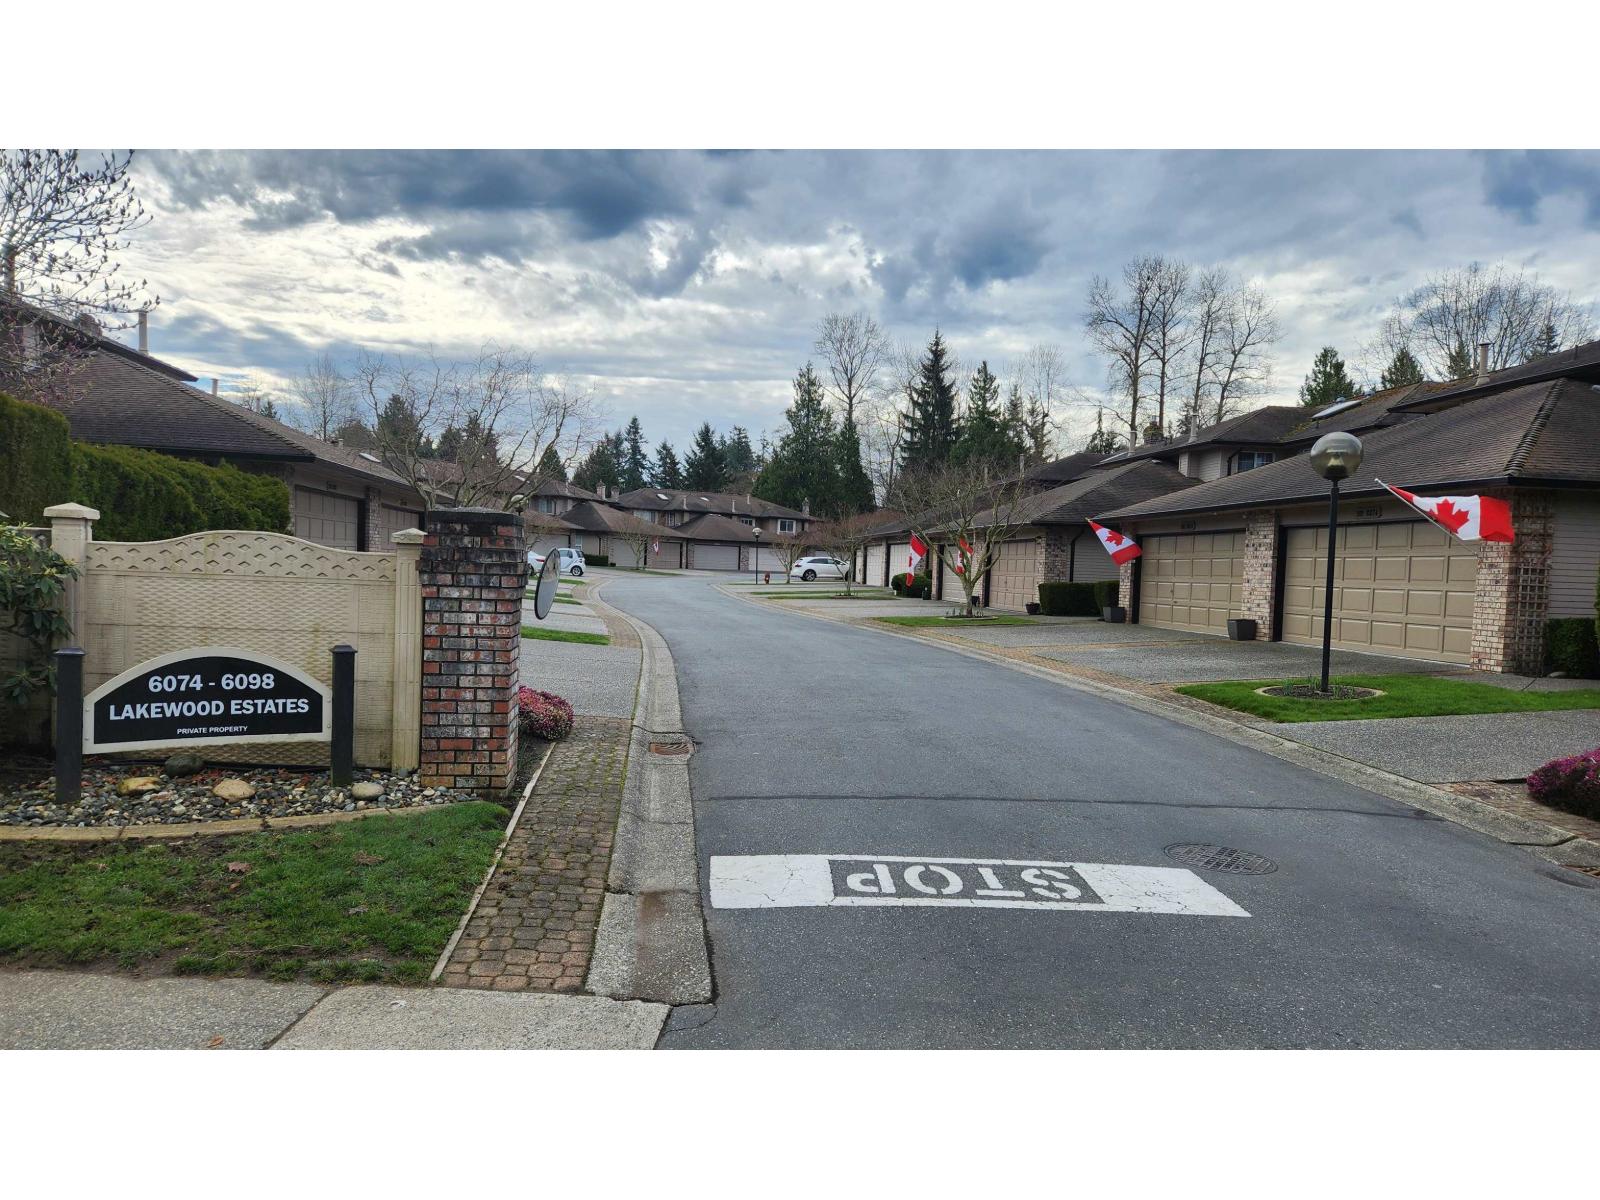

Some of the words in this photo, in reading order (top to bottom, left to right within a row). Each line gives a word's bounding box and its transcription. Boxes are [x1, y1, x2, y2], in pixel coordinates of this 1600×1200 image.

[149, 675, 203, 692] 6074
[221, 673, 275, 689] 6098
[109, 700, 224, 720] LAKEWOOD
[230, 698, 309, 714] ESTATES
[177, 726, 207, 734] PRIVATE
[209, 725, 248, 733] PROPERTY
[846, 863, 1082, 899] STOP
